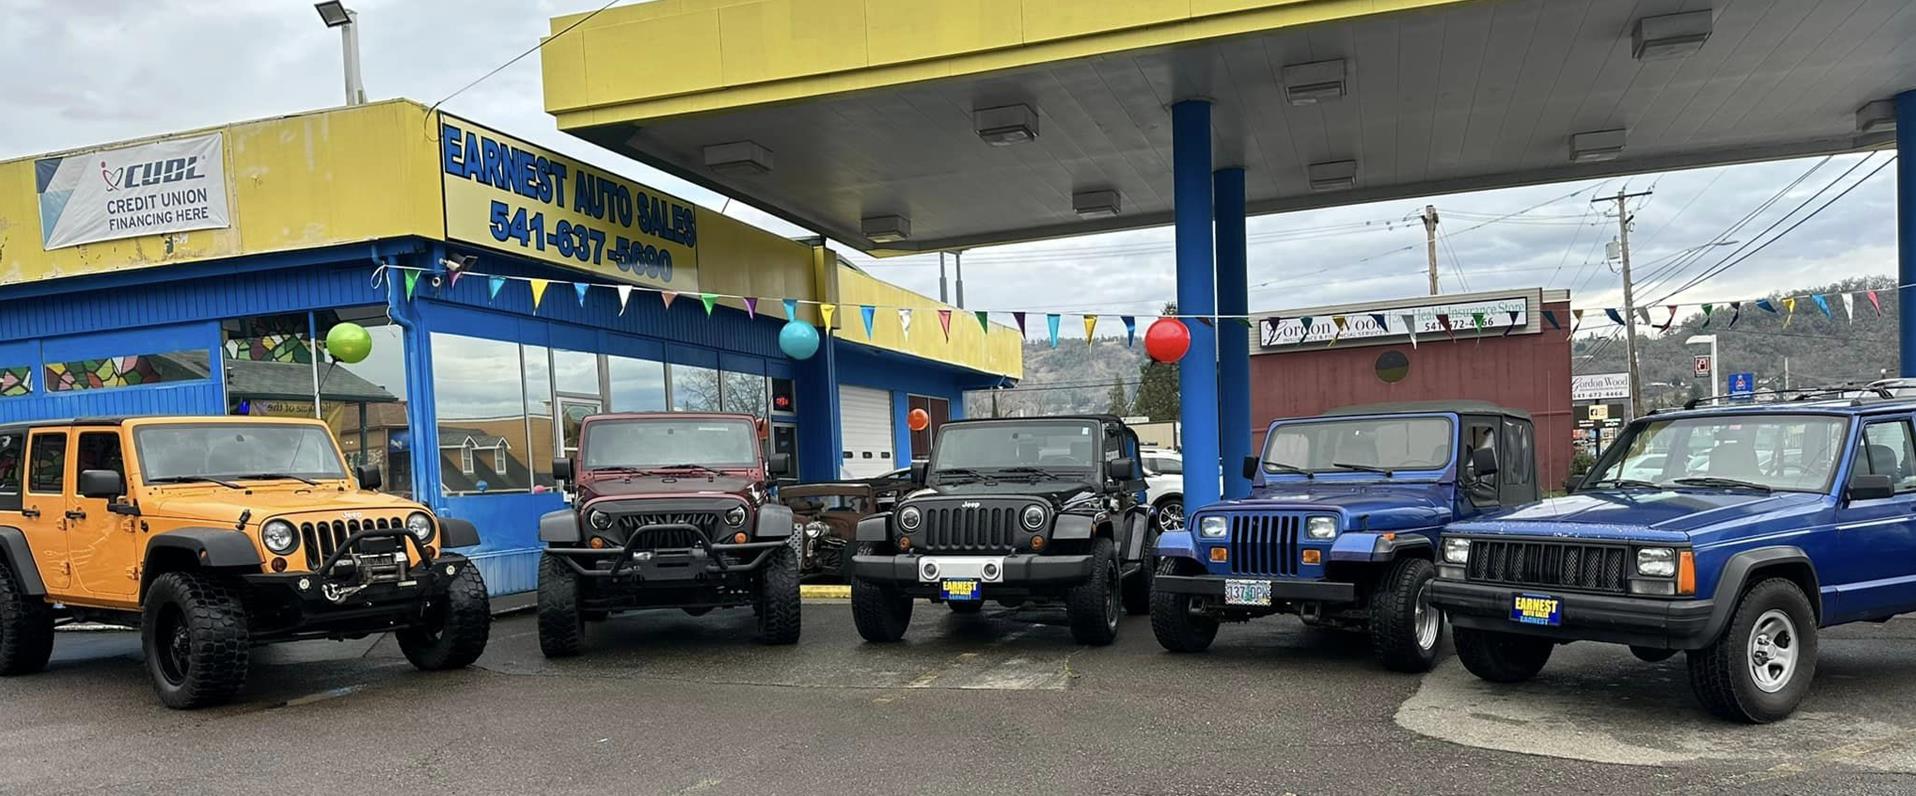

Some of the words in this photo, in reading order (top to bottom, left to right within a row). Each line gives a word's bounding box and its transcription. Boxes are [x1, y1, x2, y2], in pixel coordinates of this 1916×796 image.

[125, 156, 205, 188] CUDL
[442, 123, 567, 208] EARNEST
[574, 170, 632, 228] AUTO
[637, 192, 696, 247] SALES
[107, 194, 156, 214] CREDIT
[162, 188, 207, 206] UNION
[109, 211, 172, 231] FINANCING
[176, 207, 208, 222] HERE
[490, 200, 672, 282] 541-637-5690
[962, 501, 980, 509] Jeep
[1516, 597, 1558, 613] EARNEST
